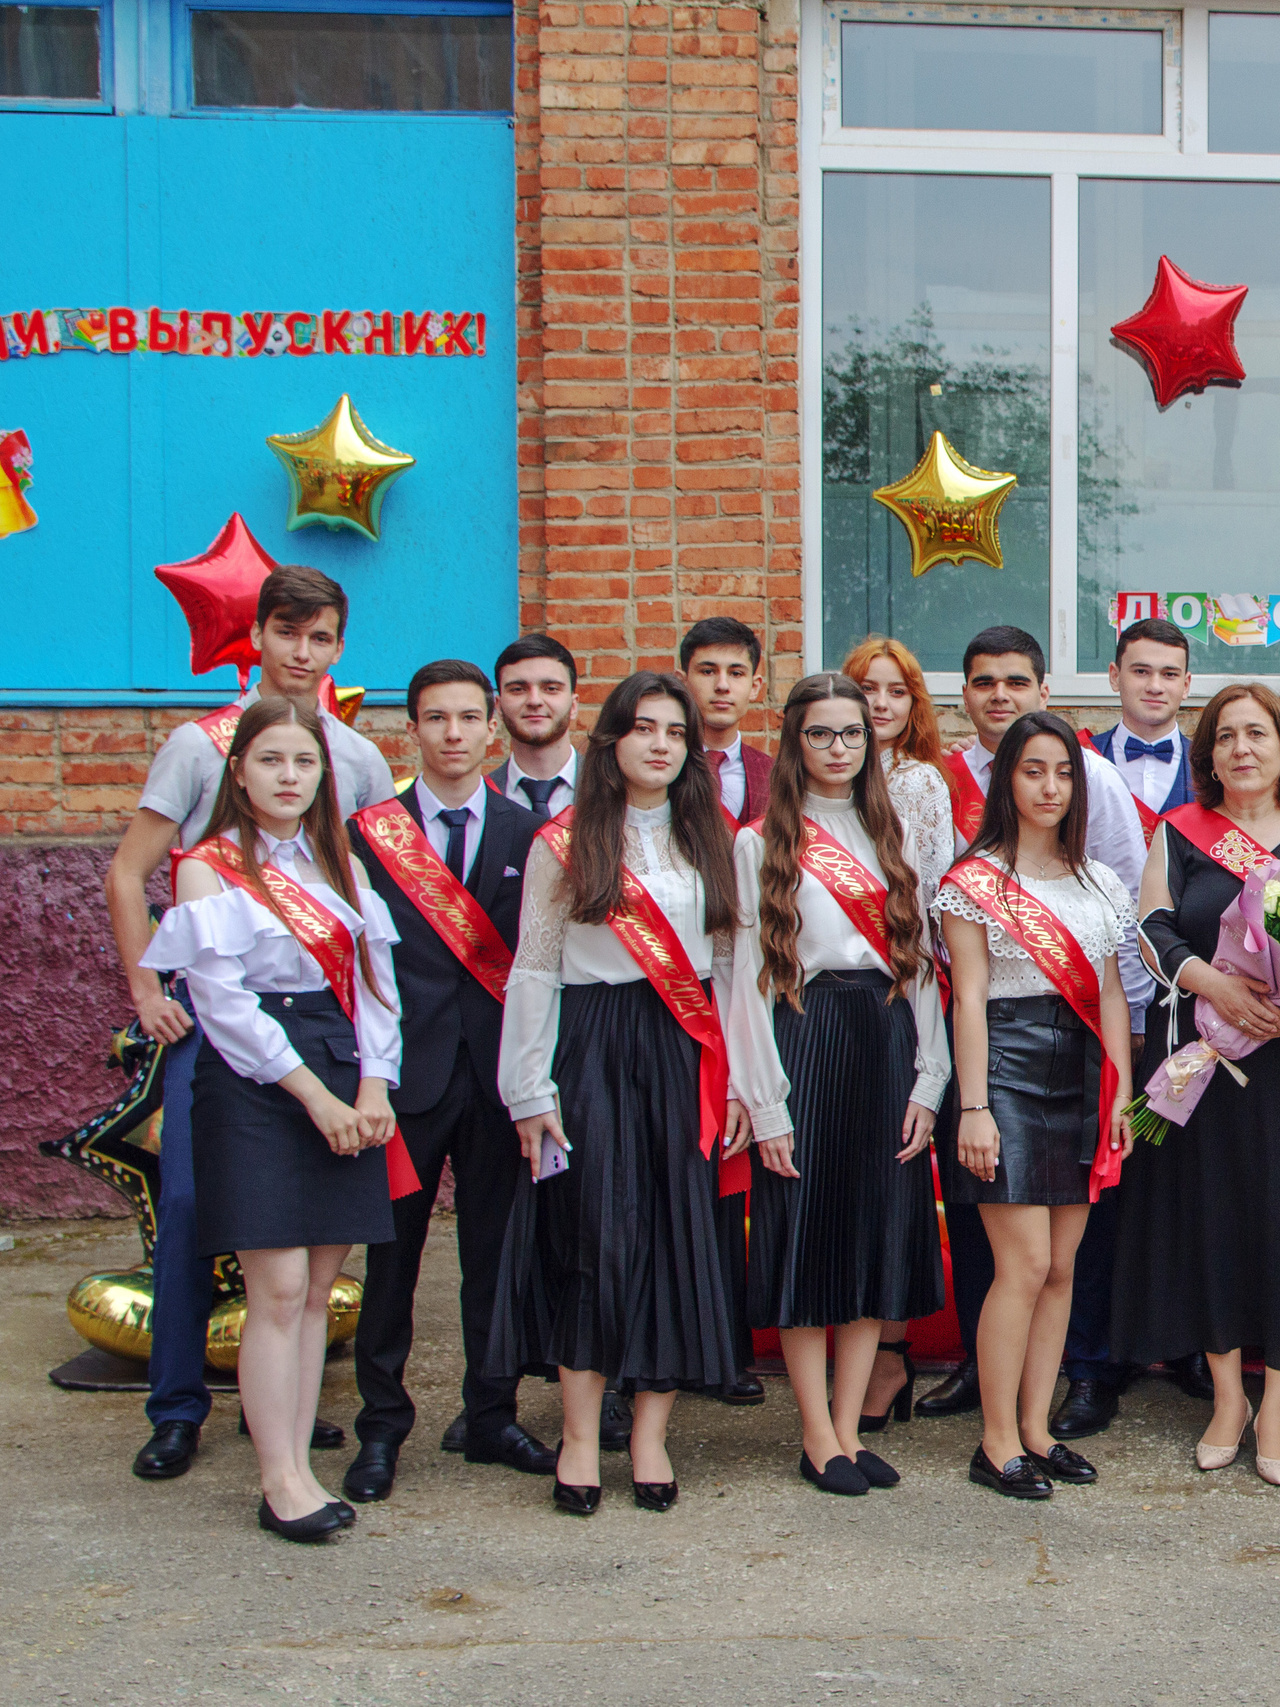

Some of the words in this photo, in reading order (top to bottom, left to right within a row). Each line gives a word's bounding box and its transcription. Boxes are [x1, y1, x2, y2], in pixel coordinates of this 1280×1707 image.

[0, 309, 61, 359] И,
[109, 307, 486, 356] ВЫПУСКНИК!
[1120, 595, 1203, 632] ДО
[805, 843, 887, 938] Выпускни
[658, 974, 712, 1020] 2021
